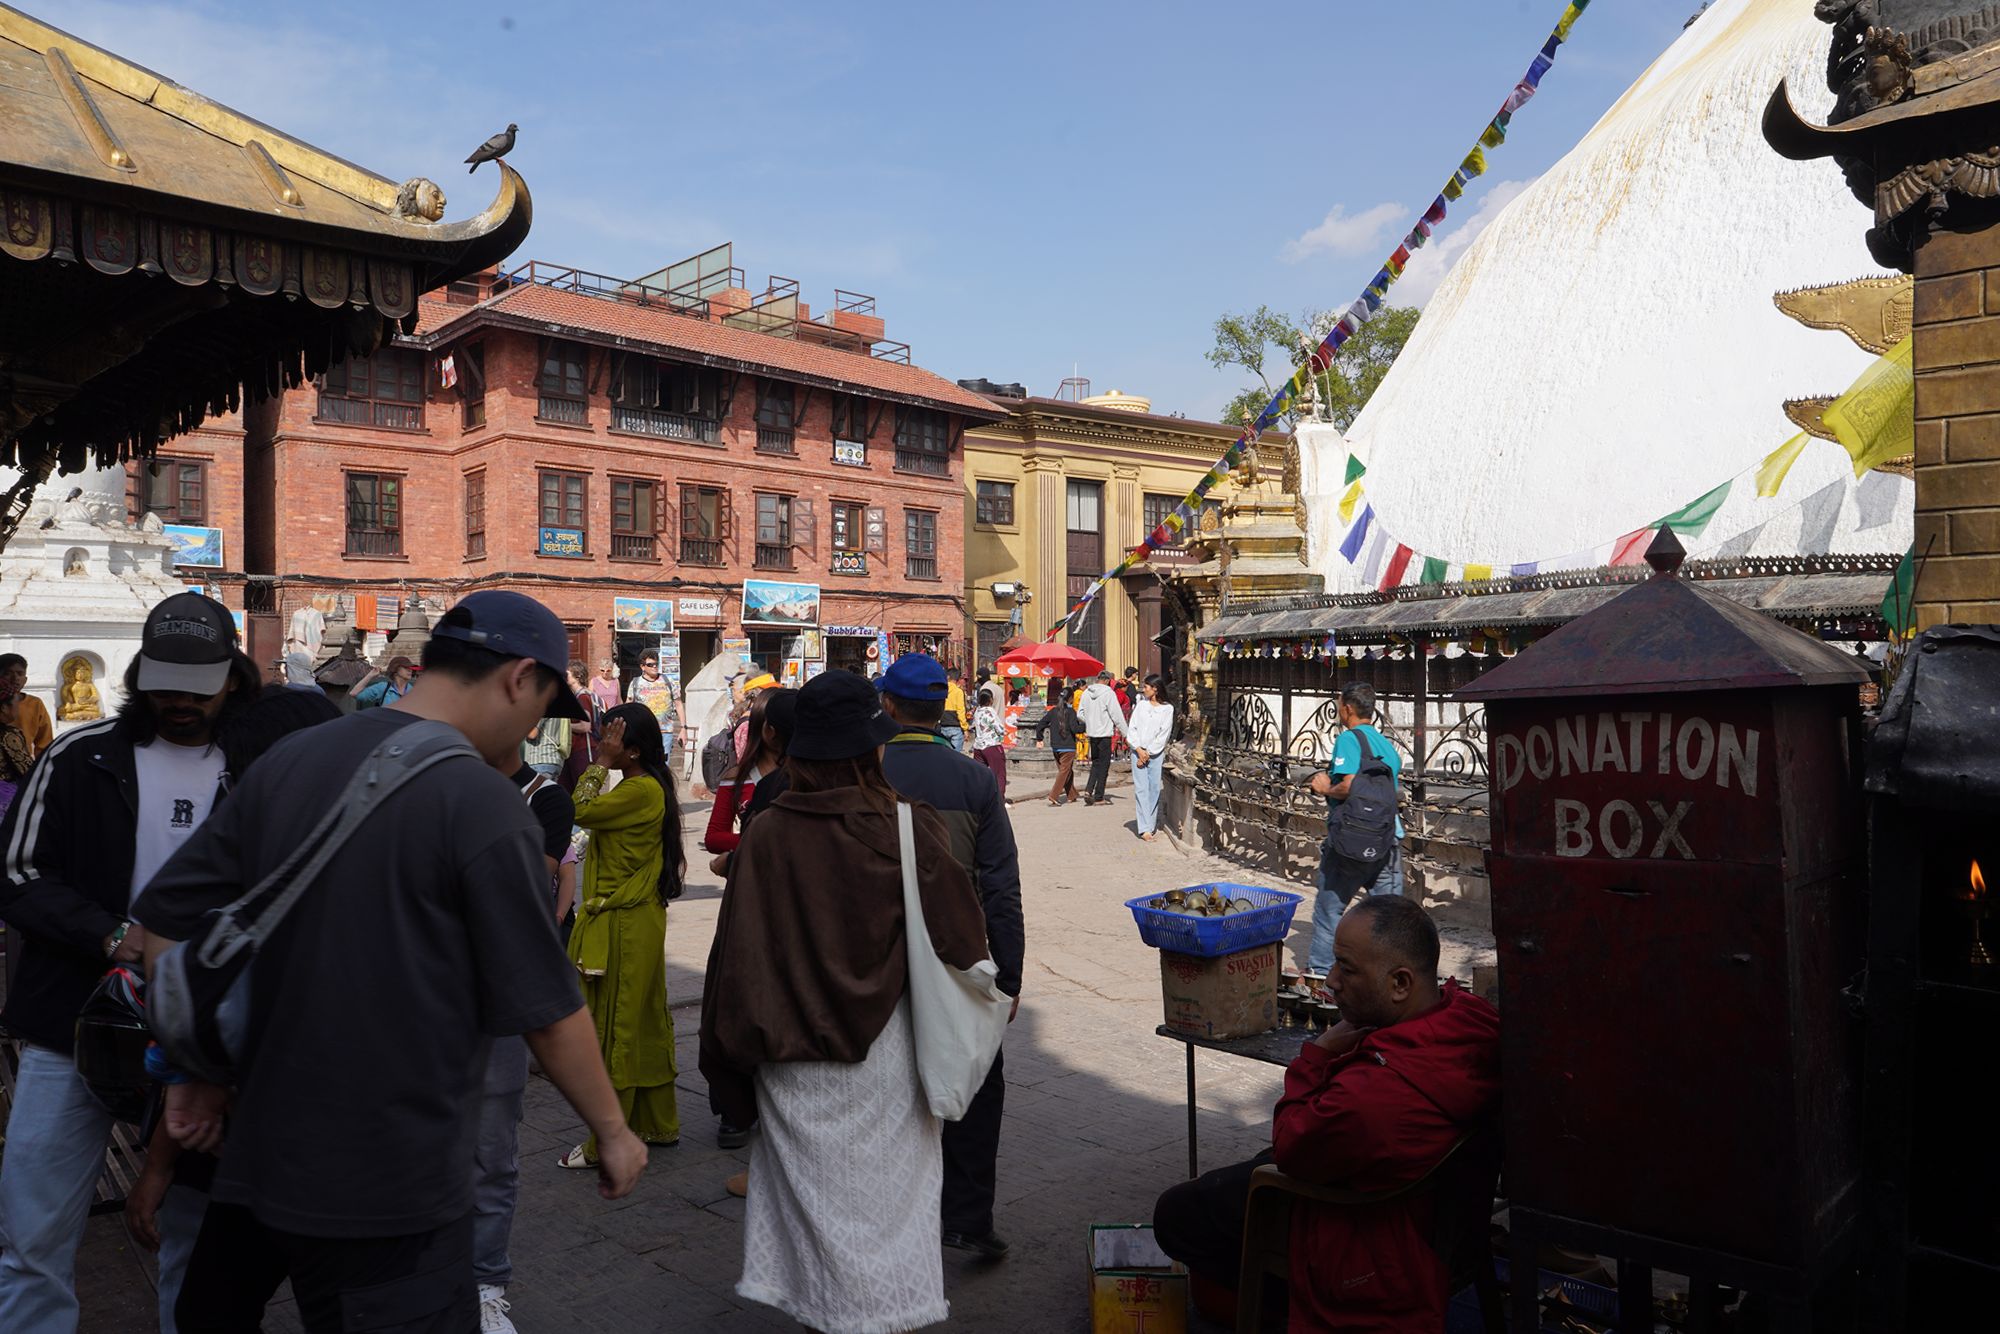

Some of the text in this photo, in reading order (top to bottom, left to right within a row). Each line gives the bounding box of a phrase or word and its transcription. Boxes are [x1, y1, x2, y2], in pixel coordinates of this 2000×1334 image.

[680, 602, 698, 610] CAFE
[828, 627, 872, 635] Bubble Tea
[1495, 711, 1760, 797] DONATION
[1554, 798, 1696, 859] BOX
[1227, 952, 1275, 976] SWASTIK
